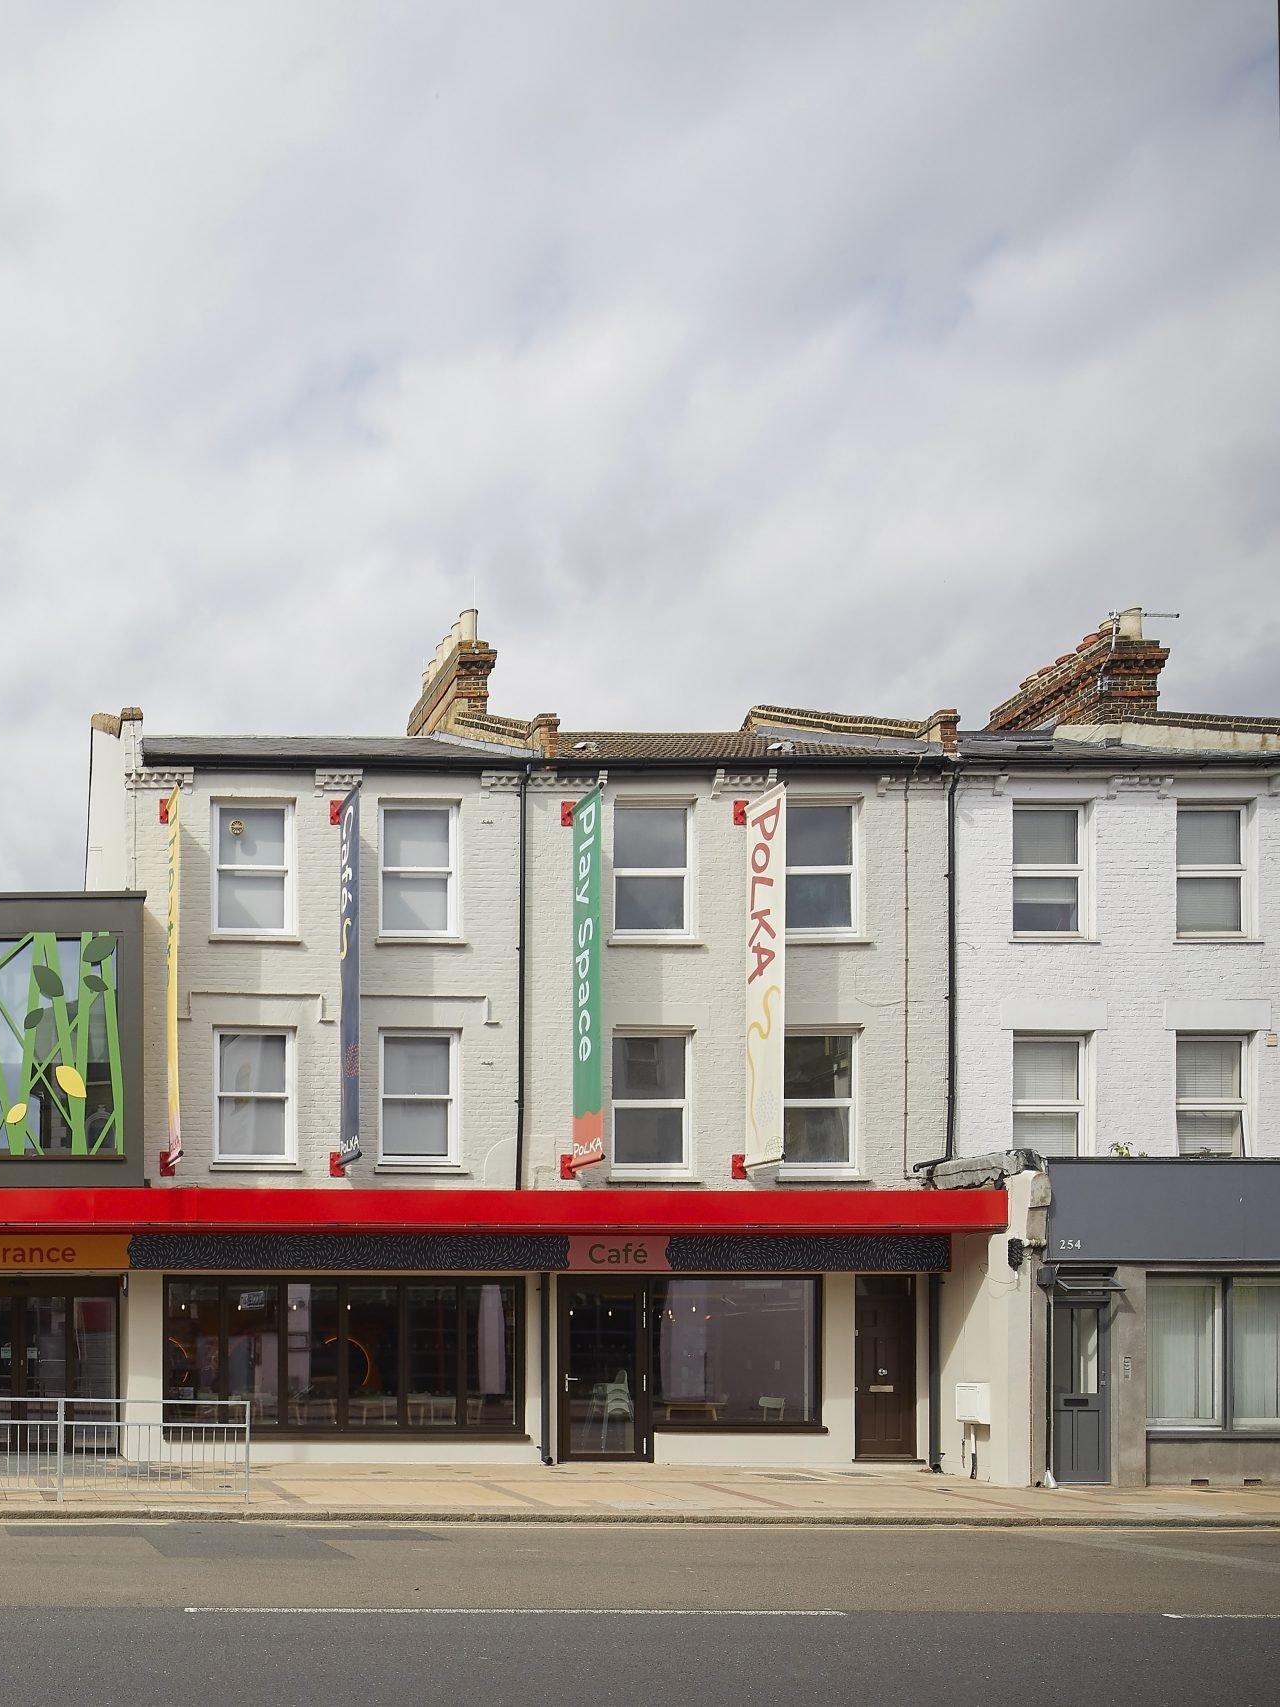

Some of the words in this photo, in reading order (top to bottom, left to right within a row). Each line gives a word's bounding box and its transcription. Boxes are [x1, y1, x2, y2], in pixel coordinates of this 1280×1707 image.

[341, 805, 354, 914] Café
[576, 802, 595, 904] Play
[748, 798, 781, 985] POLKA
[576, 917, 593, 1062] Space
[573, 1137, 603, 1158] POLKA
[588, 1243, 648, 1264] Café
[1059, 1239, 1082, 1250] 254
